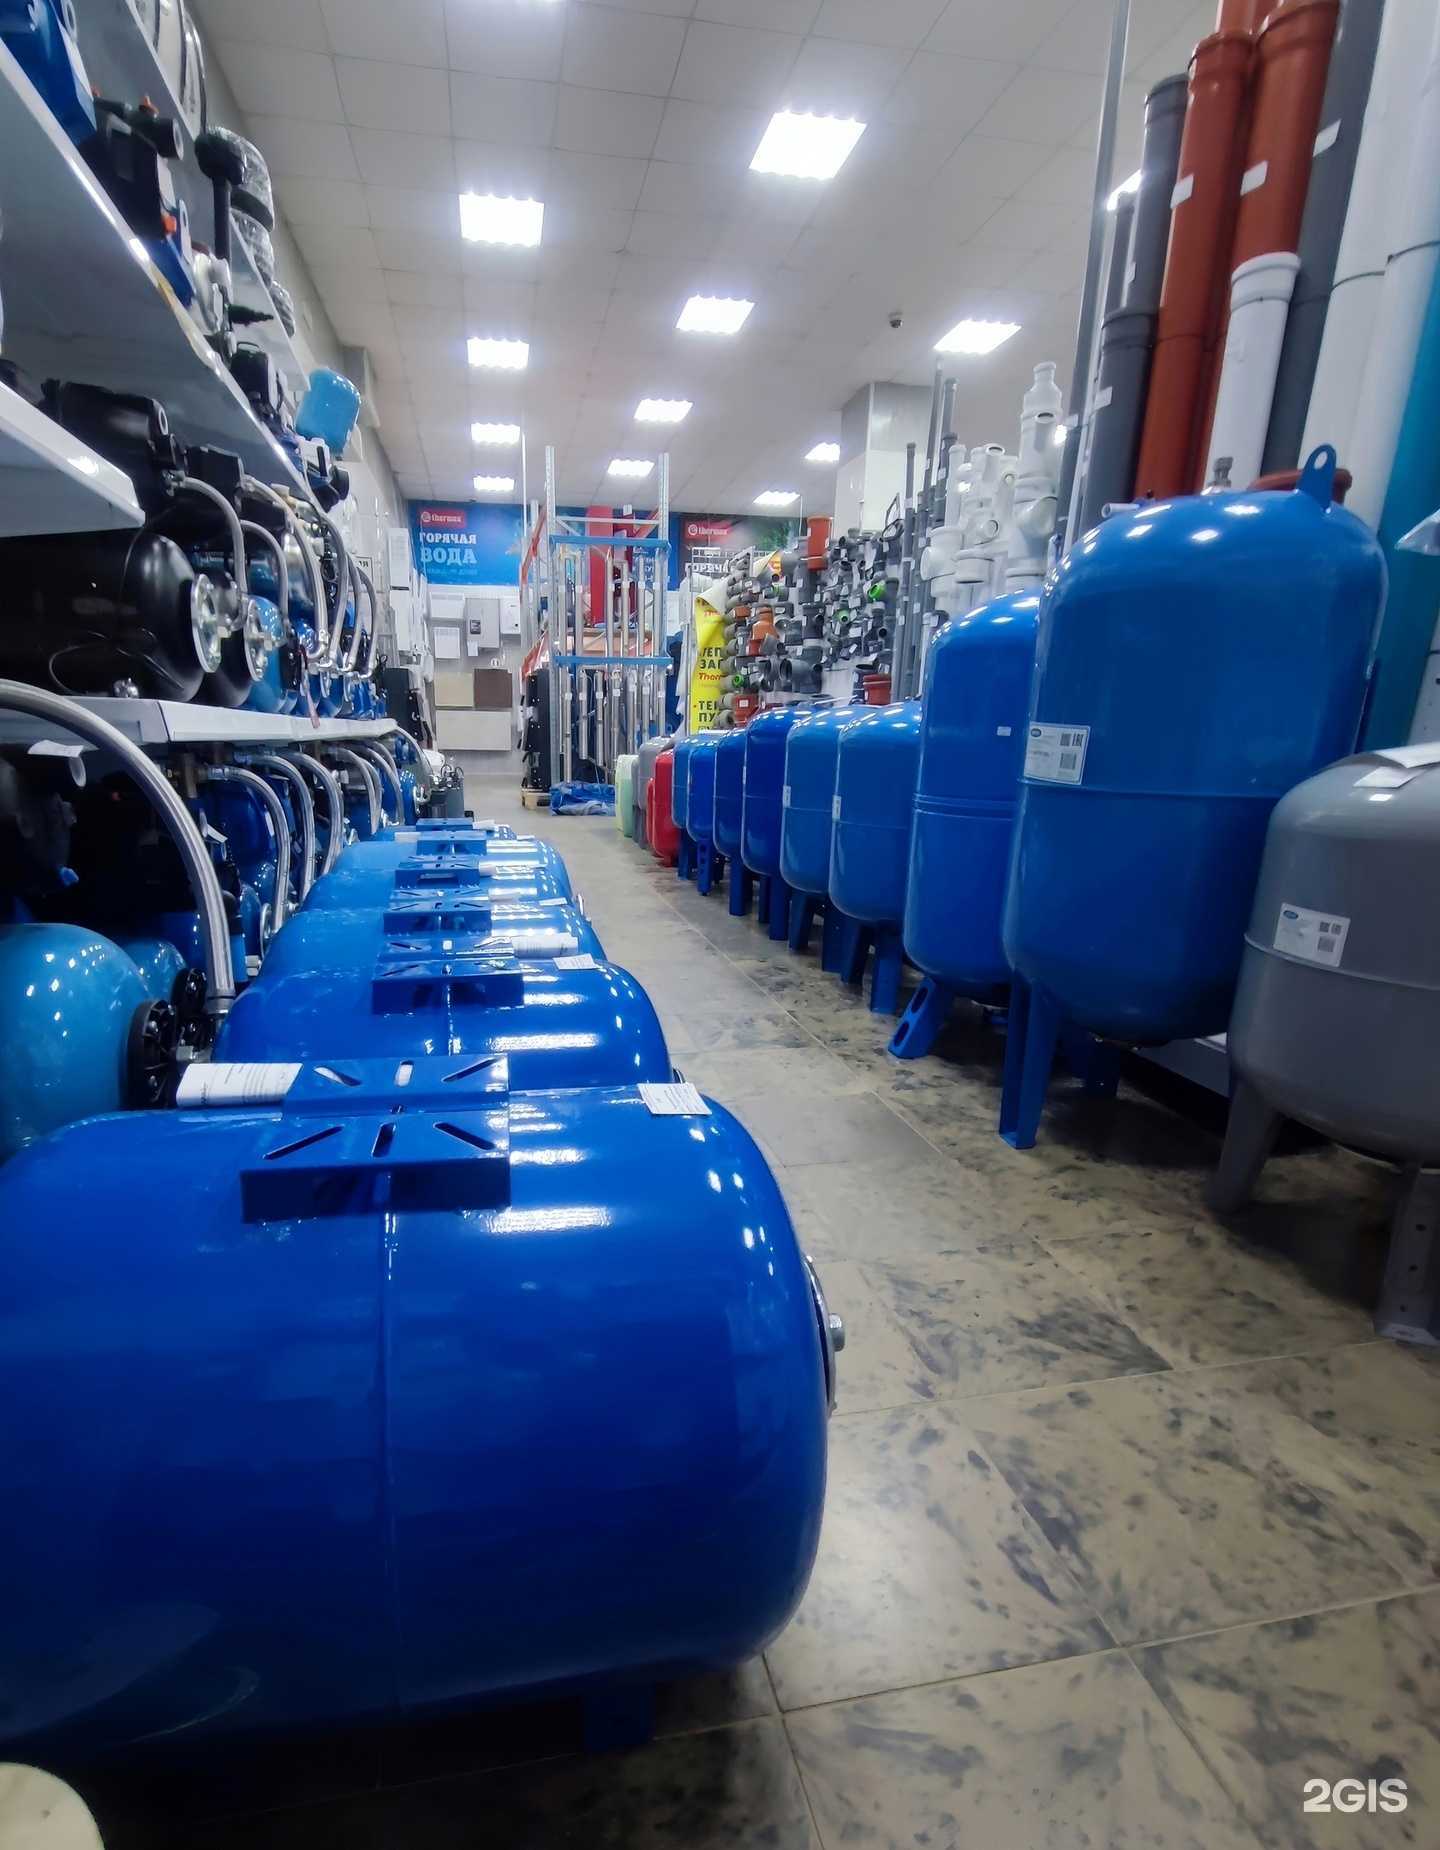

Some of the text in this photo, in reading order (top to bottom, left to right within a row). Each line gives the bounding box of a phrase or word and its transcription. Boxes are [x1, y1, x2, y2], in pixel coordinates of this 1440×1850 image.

[419, 532, 477, 545] ГОРЯЧАЯ
[420, 547, 478, 567] ВОДА
[684, 562, 729, 573] ГОРЯЧА
